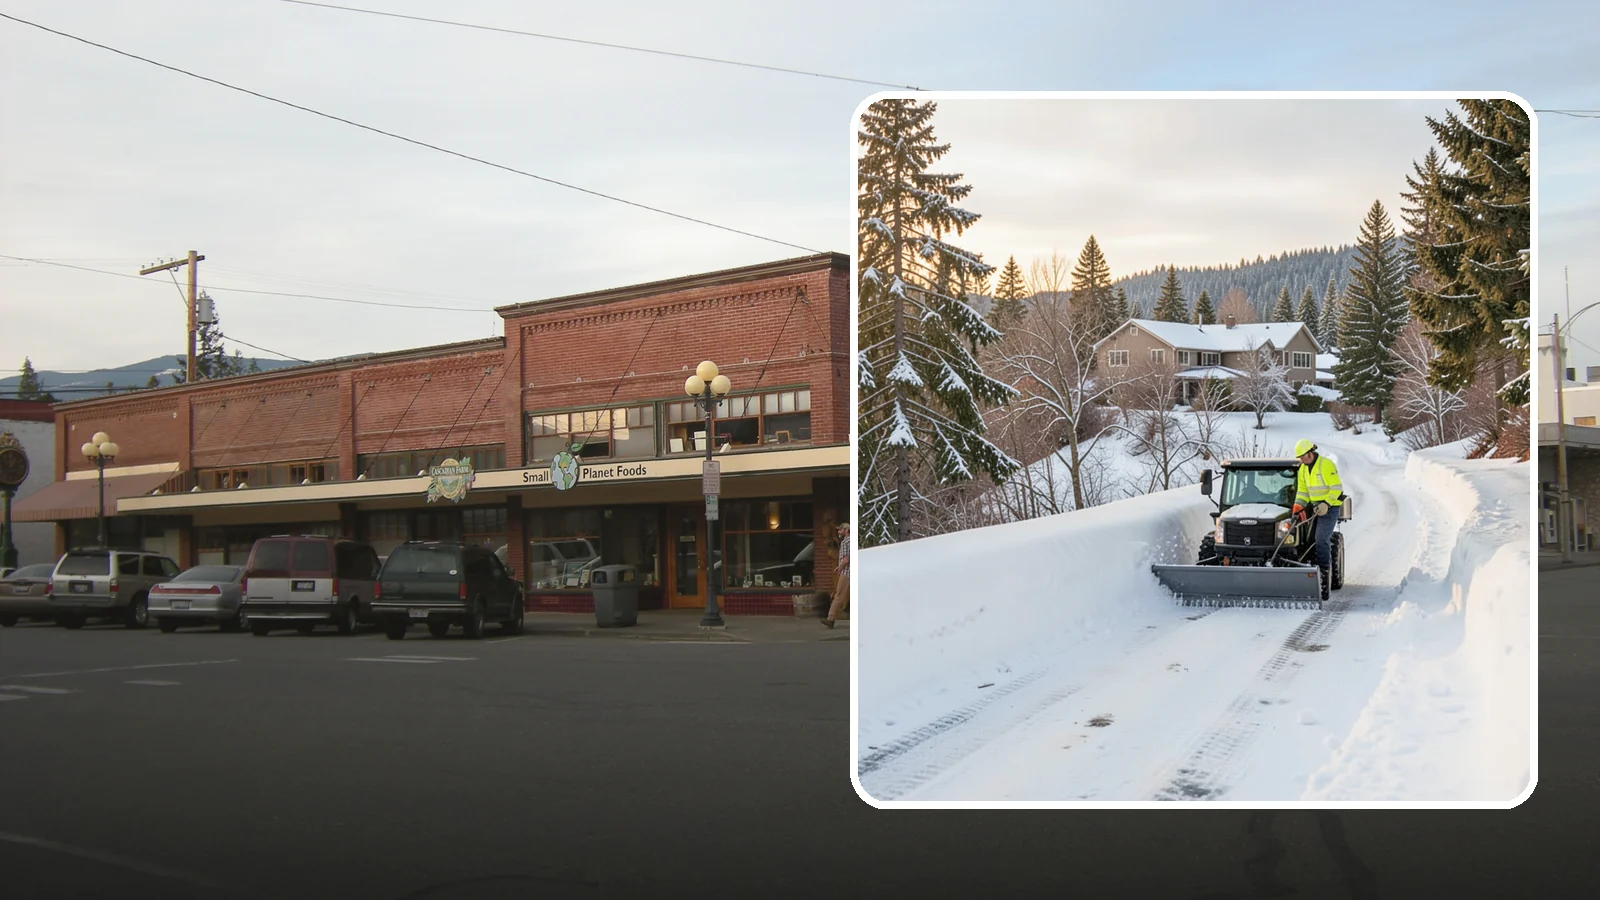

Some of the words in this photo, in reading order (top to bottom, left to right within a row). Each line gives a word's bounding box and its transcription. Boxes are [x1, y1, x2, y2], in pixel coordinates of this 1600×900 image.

[523, 470, 549, 483] Small
[583, 467, 614, 480] Planet
[617, 464, 647, 477] Foods
